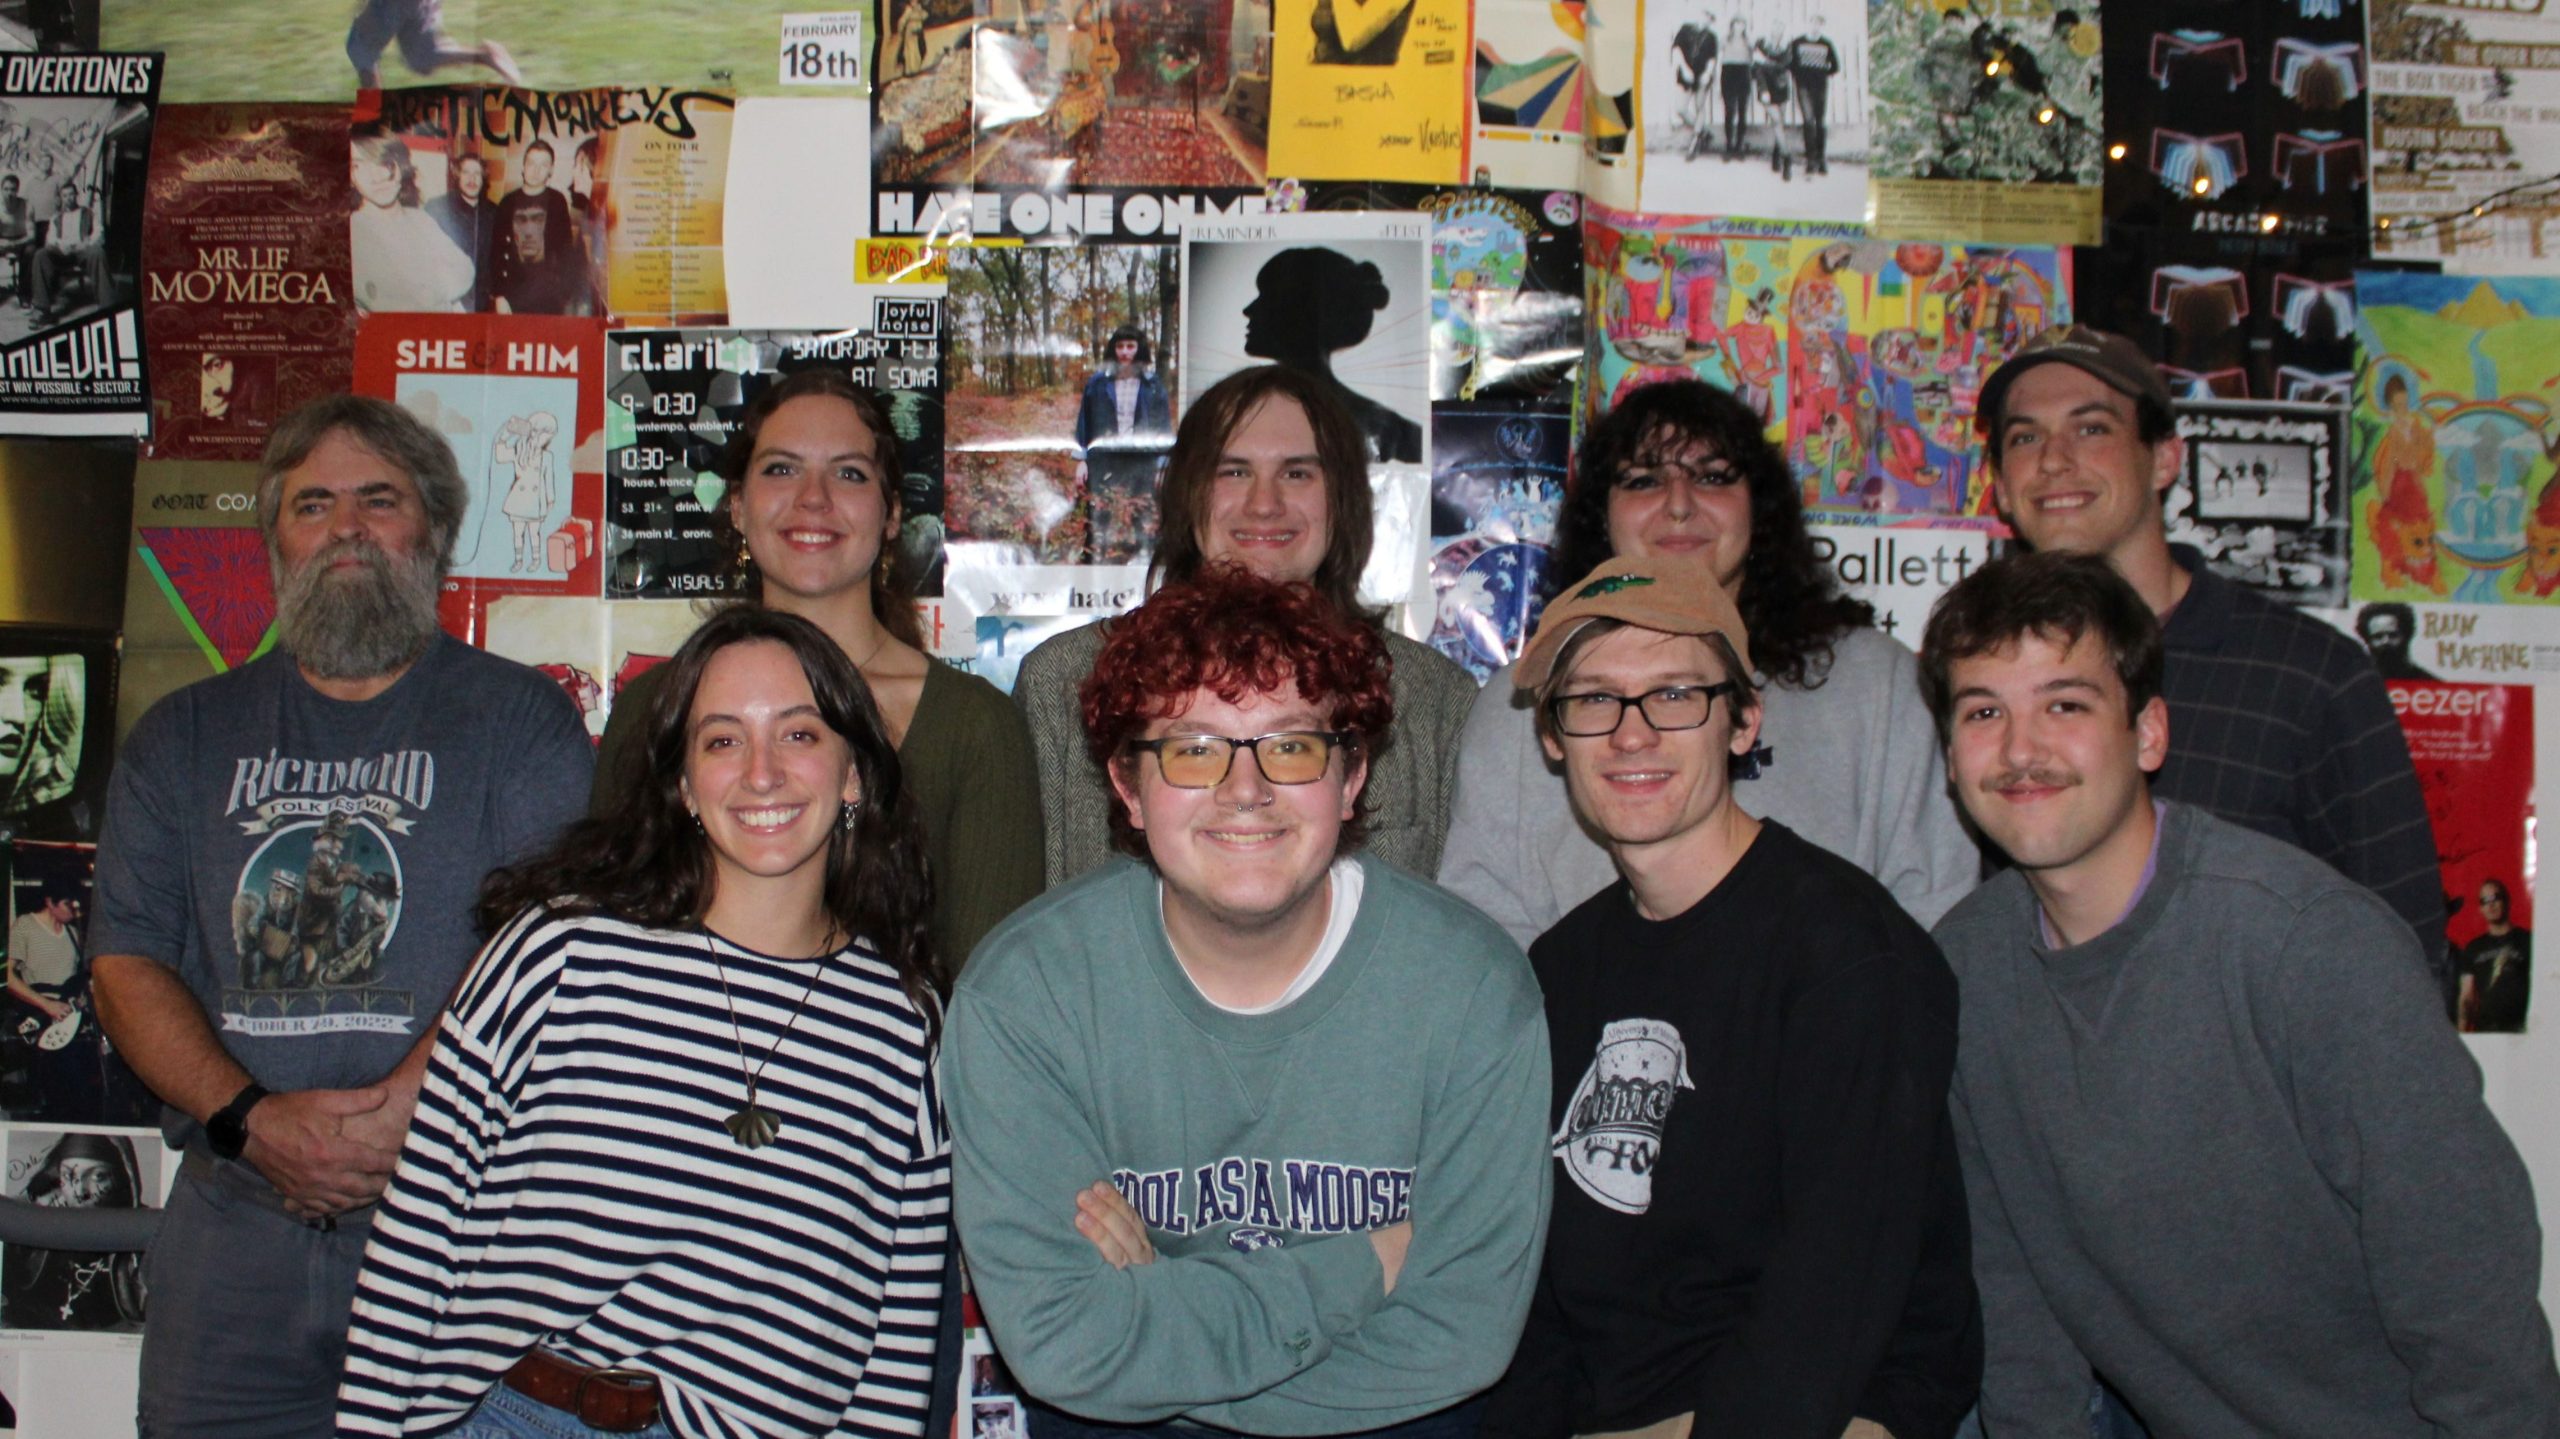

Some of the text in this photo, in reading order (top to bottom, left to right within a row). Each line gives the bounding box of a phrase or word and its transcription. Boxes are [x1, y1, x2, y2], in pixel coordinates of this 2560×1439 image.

[784, 23, 857, 38] FEBRUARY
[782, 42, 857, 78] 18th
[5, 55, 153, 94] OVERTONES
[644, 141, 700, 152] ON TOUR
[1010, 192, 1112, 235] ONE
[1122, 192, 1195, 235] ON
[1196, 225, 1278, 240] REMINDER
[1707, 220, 1758, 235] WOKE
[1761, 222, 1785, 236] ON
[1791, 223, 1803, 236] A
[199, 248, 289, 270] MR. LIF
[395, 339, 467, 370] SHE
[506, 341, 580, 374] HIM
[791, 337, 890, 360] SATURDAY
[851, 366, 938, 390] AT SOMA
[13, 381, 34, 394] WAY
[35, 381, 81, 395] POSSIBLE
[93, 381, 131, 395] SECTOR
[653, 393, 696, 416] 10:30
[623, 478, 658, 489] house,
[152, 494, 209, 512] GOAT
[635, 528, 662, 540] main
[667, 573, 725, 592] VISUALS
[2388, 687, 2495, 716] eezer.
[269, 797, 392, 815] FOLK FESTVAL
[344, 1015, 394, 1030] 2022
[1284, 1158, 1416, 1235] MOOSE
